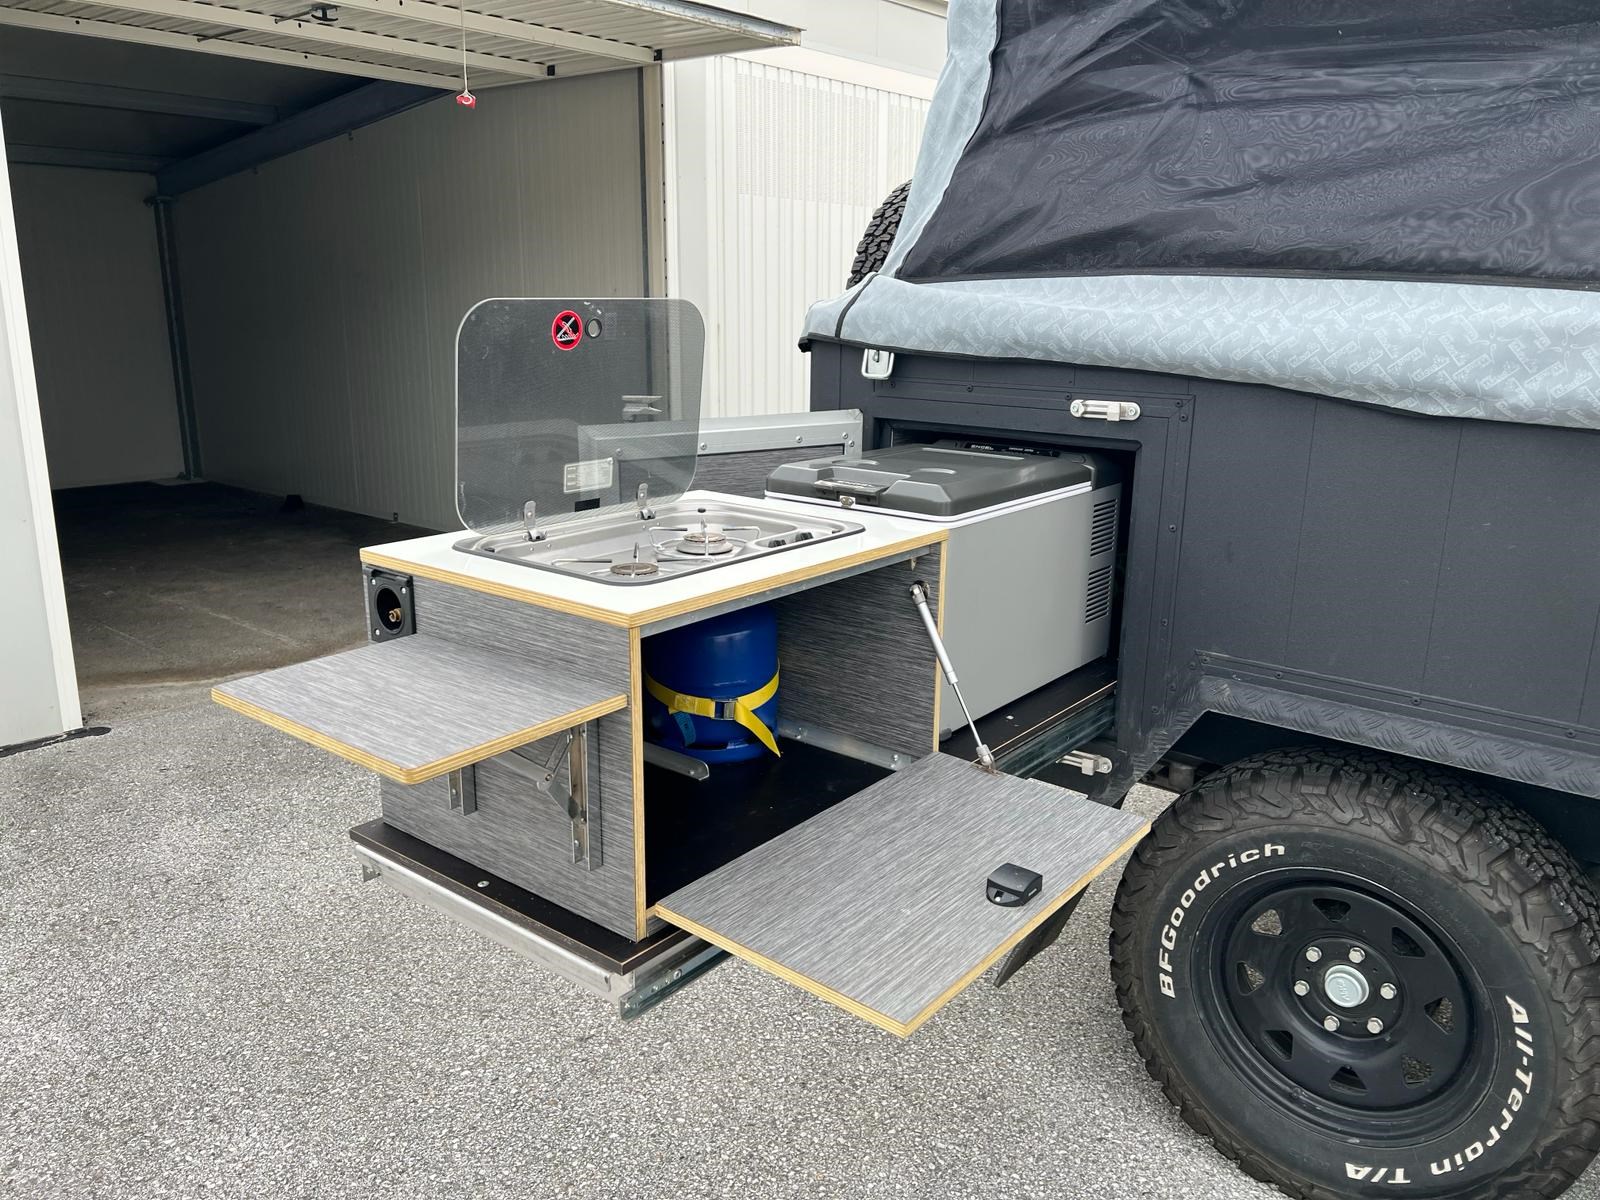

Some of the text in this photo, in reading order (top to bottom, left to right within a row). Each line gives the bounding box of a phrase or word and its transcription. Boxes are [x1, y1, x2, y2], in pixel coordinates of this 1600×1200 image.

[1158, 843, 1286, 999] BFGoodrich
[1344, 995, 1534, 1184] All-Terrain T/A
